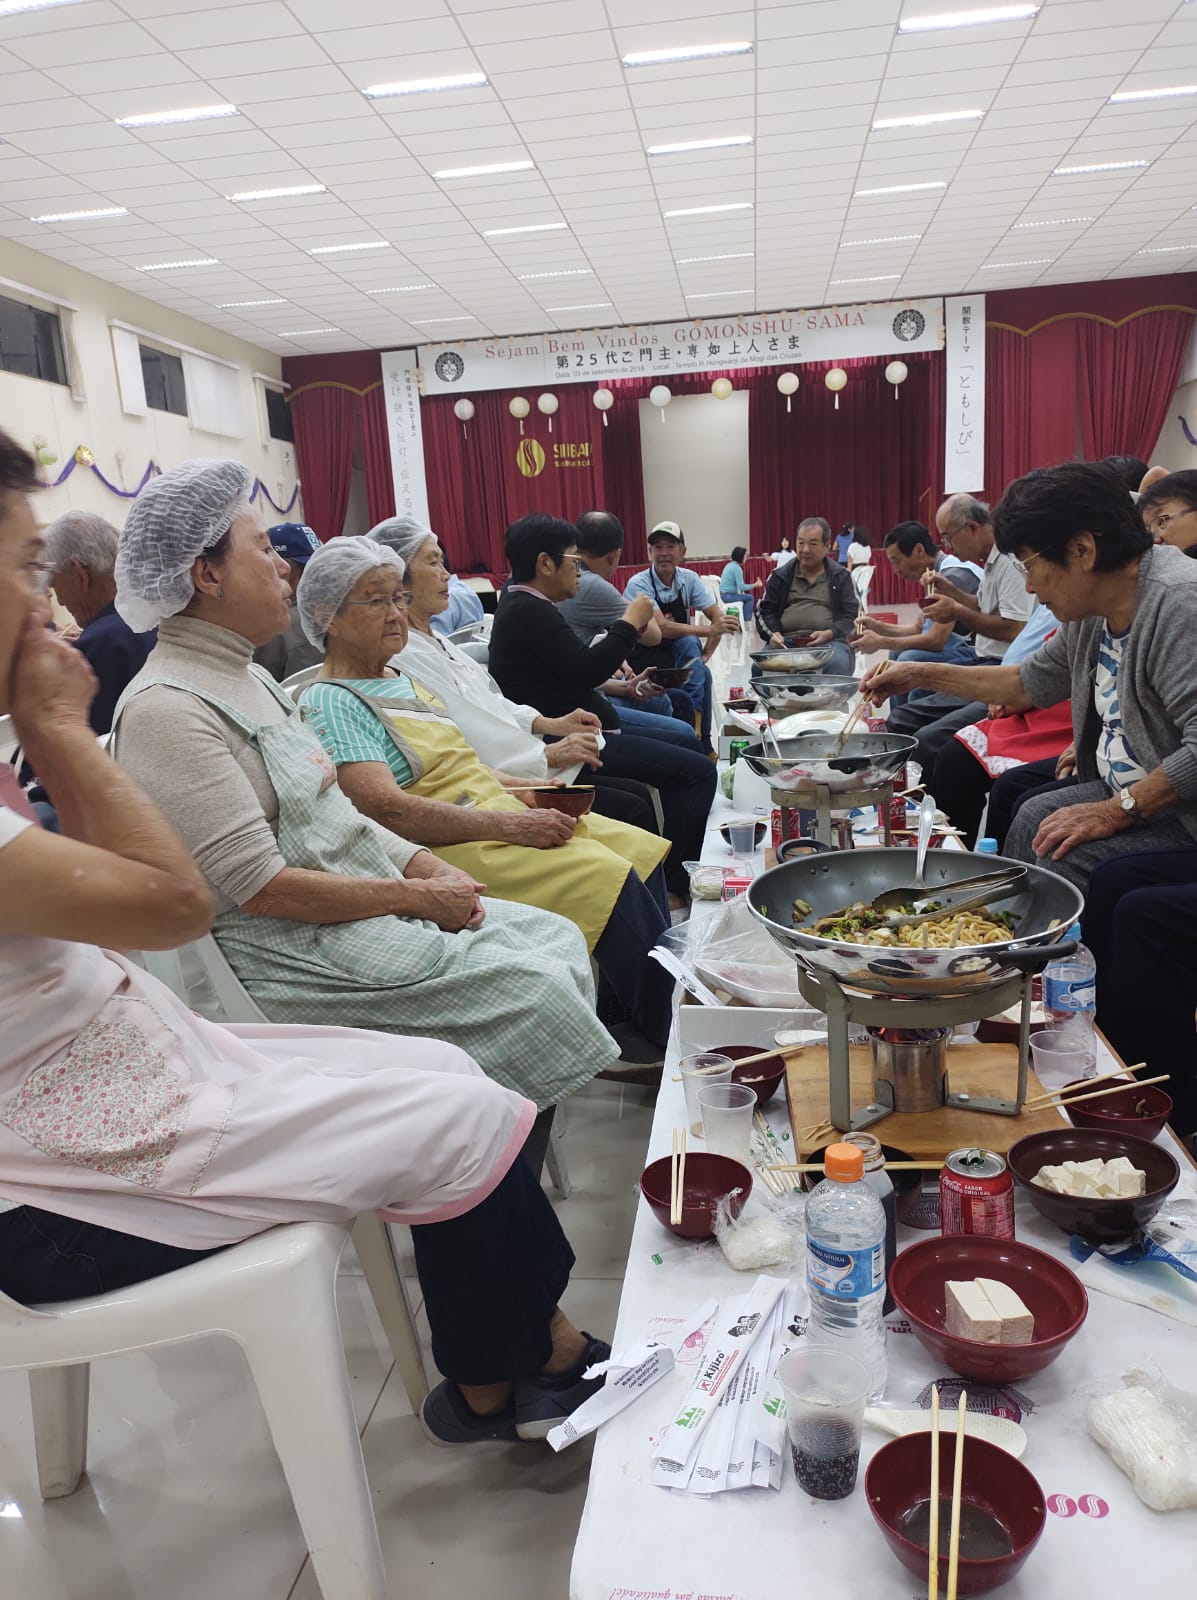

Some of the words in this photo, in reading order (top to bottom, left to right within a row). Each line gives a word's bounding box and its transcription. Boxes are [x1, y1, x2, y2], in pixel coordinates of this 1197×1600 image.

[485, 345, 539, 360] Sejam
[548, 339, 585, 353] Bem
[596, 333, 659, 349] Vindos
[704, 1352, 725, 1379] Kijiro
